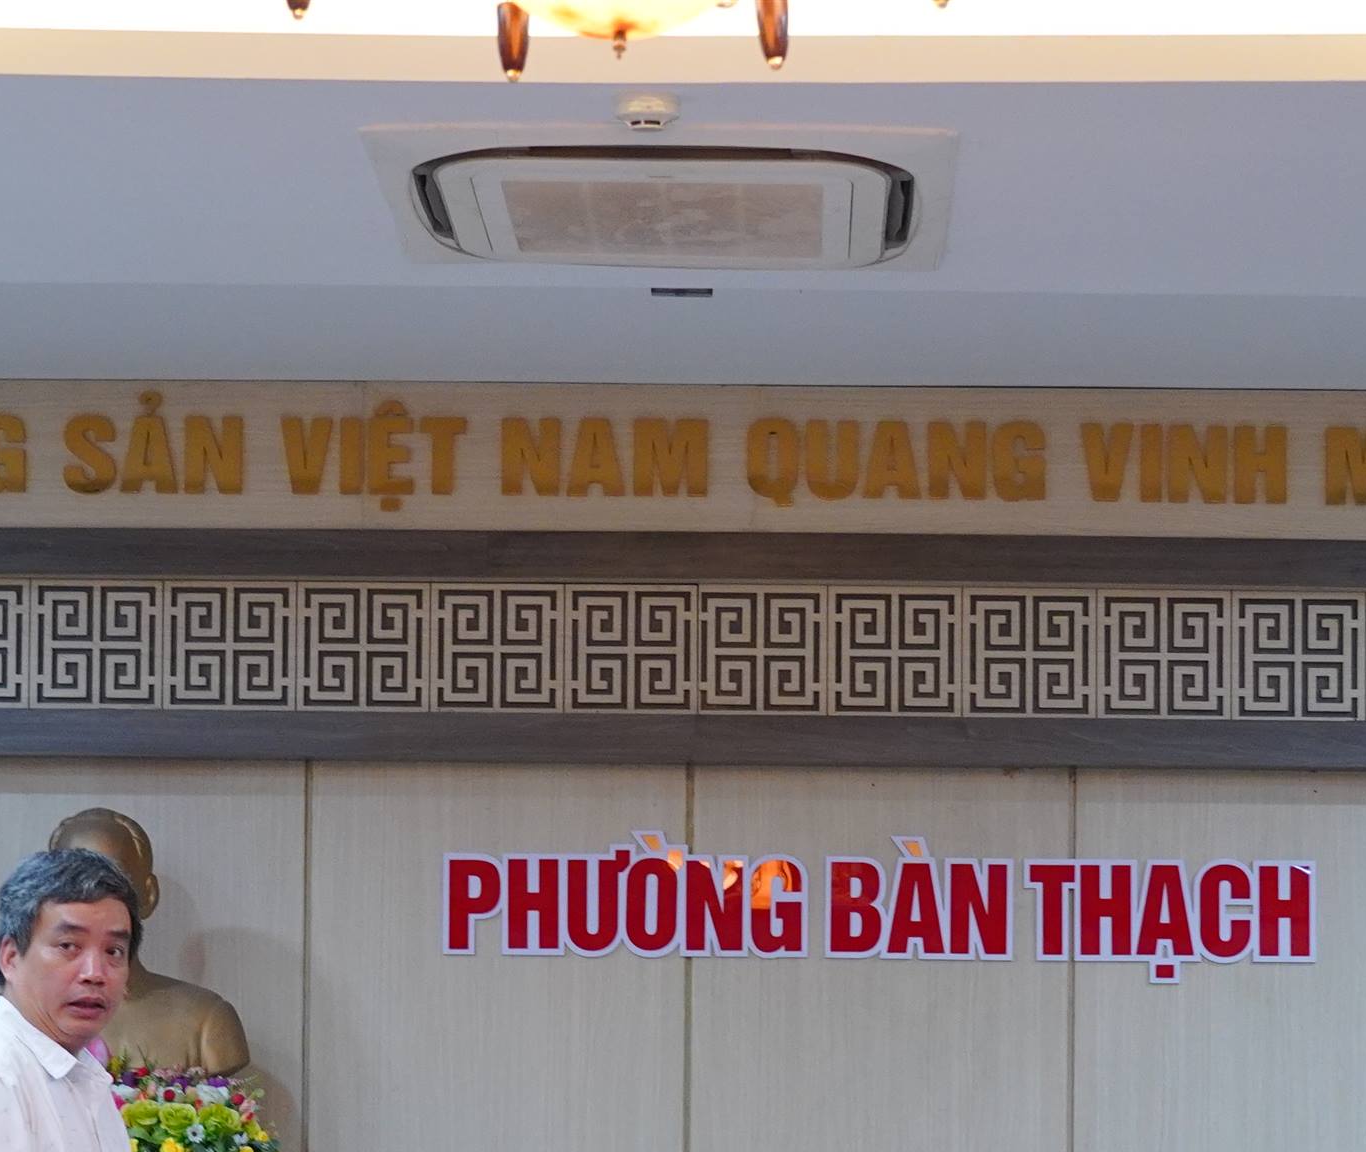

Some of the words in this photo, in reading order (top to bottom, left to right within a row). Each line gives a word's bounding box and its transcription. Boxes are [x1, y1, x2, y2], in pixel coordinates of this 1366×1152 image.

[63, 390, 245, 495] SẢN
[279, 399, 468, 512] VIỆT
[502, 416, 710, 498] NAM
[746, 417, 1048, 508] QUANG
[1085, 422, 1289, 506] VINH
[443, 831, 808, 958] PHƯỜNG
[825, 836, 1013, 961] BÀN
[1025, 859, 1316, 983] THẠCH
